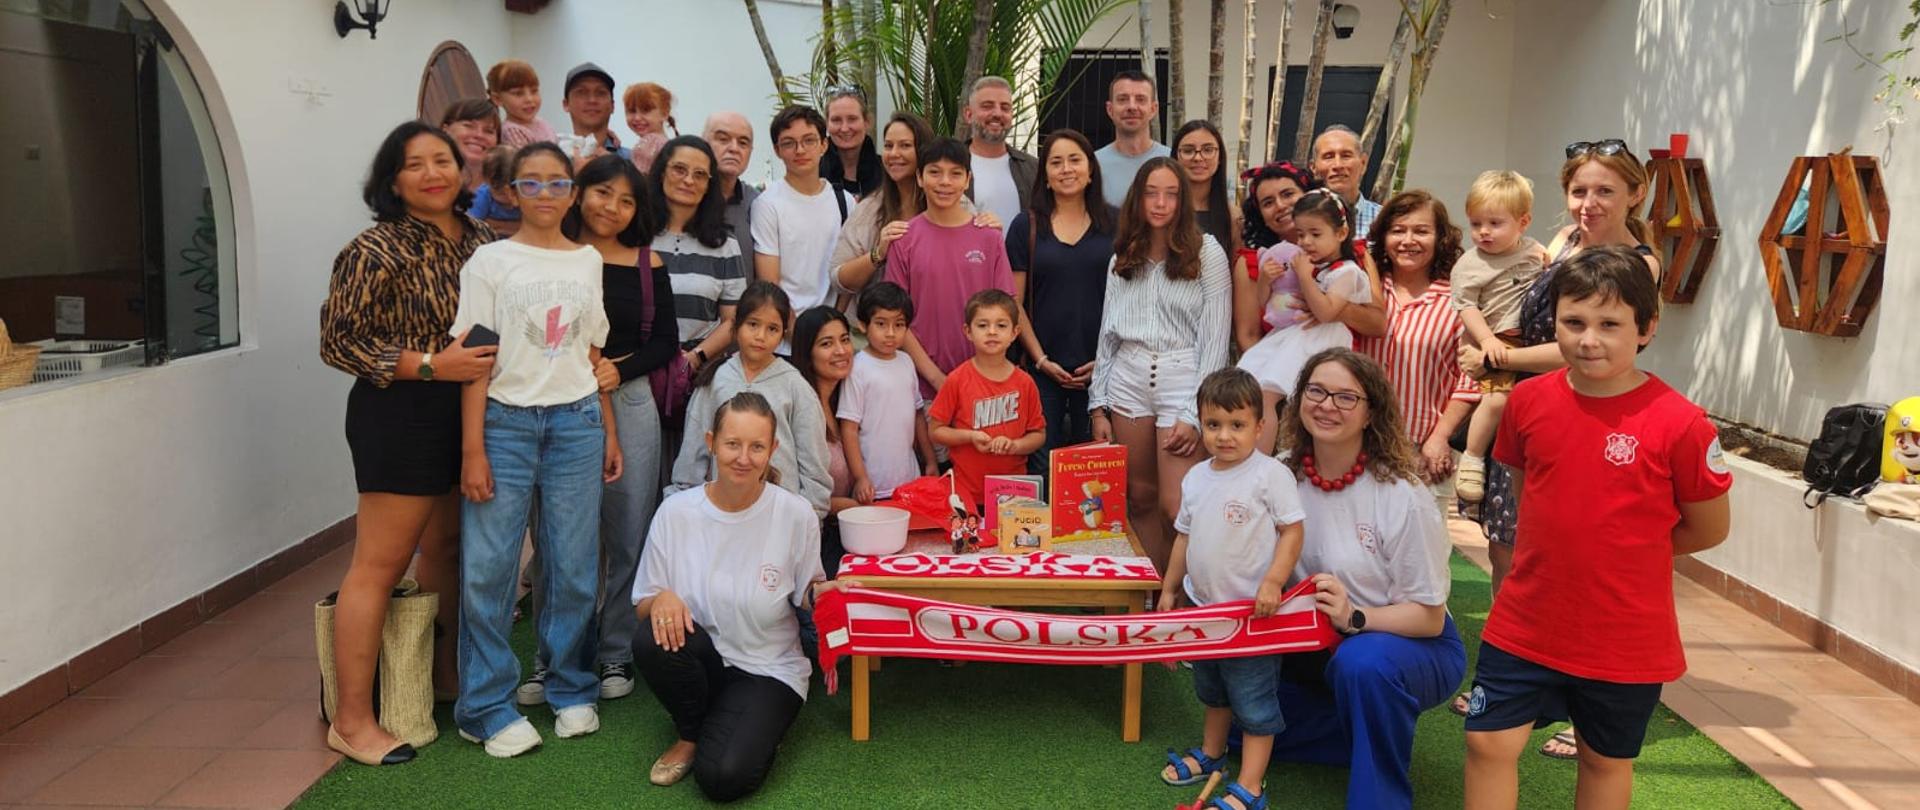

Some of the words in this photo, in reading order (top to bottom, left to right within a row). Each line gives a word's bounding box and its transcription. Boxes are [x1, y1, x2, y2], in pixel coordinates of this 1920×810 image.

[973, 391, 1019, 429] NIKE
[838, 552, 1140, 577] POLSKA
[949, 613, 1207, 646] POLSKA
